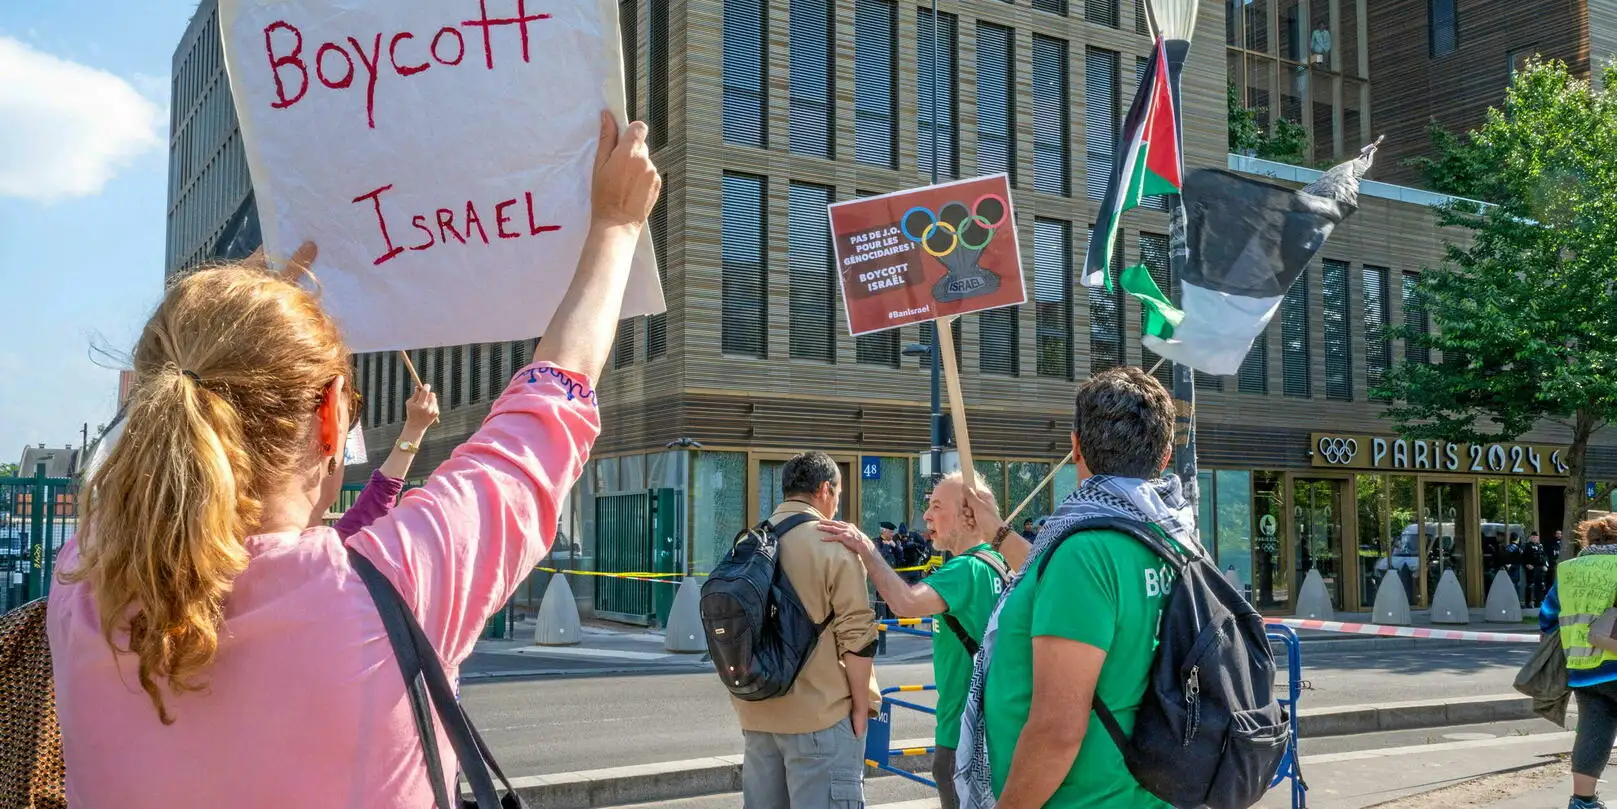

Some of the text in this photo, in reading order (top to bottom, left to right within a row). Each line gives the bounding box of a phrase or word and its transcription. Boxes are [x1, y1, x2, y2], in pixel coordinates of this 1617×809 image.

[850, 226, 901, 244] PAS DE J.O.
[856, 236, 899, 252] POUR LES
[843, 243, 910, 266] GÉNOCIDAIRES
[859, 263, 908, 282] BOYCOTT
[868, 275, 905, 291] ISRAËL
[949, 278, 984, 292] ISRAEL
[888, 304, 930, 319] #BanIsrael
[1470, 444, 1541, 473] 2024
[863, 464, 877, 477] 48
